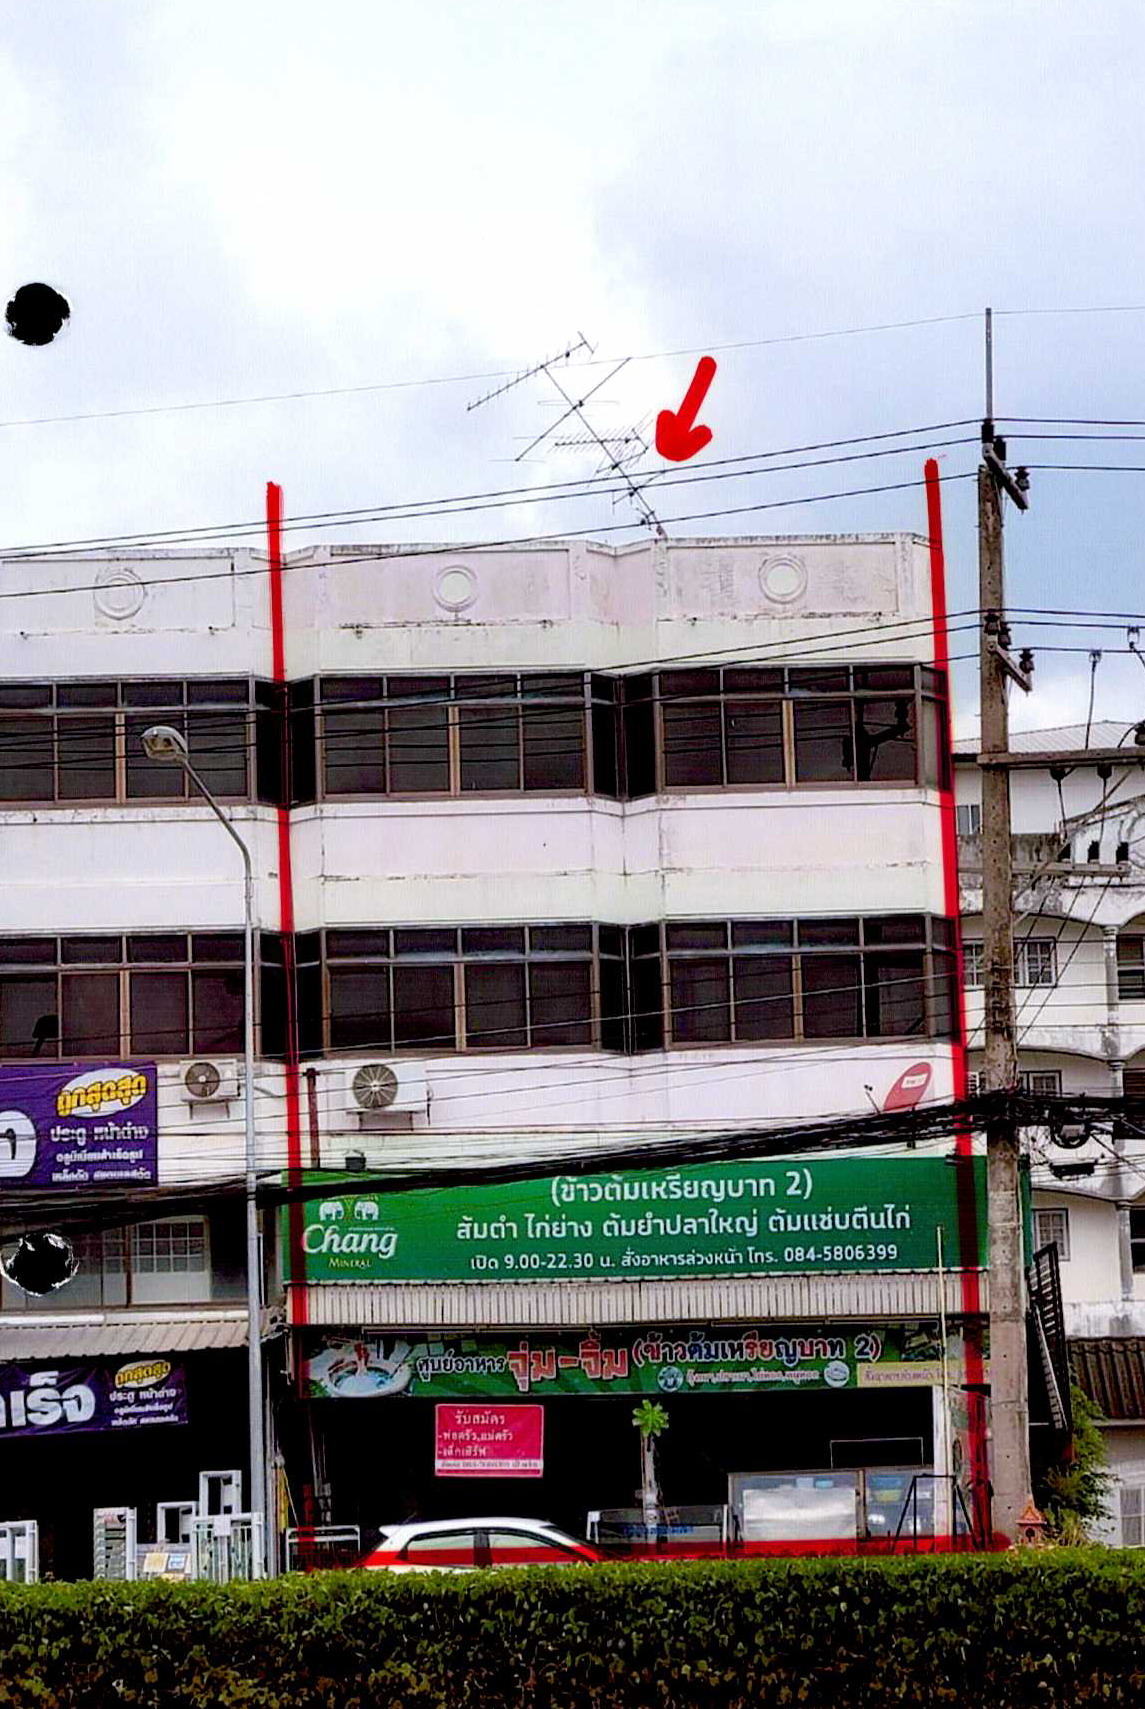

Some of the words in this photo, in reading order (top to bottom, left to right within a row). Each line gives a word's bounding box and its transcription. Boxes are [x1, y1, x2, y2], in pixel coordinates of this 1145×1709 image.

[50, 1125, 87, 1146] ประตู
[94, 1121, 149, 1141] หน้าต่าง
[552, 1171, 775, 1207] (ข้าวต้มเหรียญบาท
[786, 1168, 814, 1200] 2)
[456, 1215, 518, 1240] ส้มตำ
[524, 1213, 593, 1239] ไก่ย่าง
[602, 1208, 758, 1237] ต้มยำปลาใหญ่
[768, 1204, 911, 1233] ต้มแซ่บตีนไก่
[302, 1224, 398, 1259] Chang
[470, 1255, 499, 1270] เปิด
[504, 1252, 593, 1270] 9.00-22.30
[600, 1255, 615, 1268] น.
[621, 1246, 743, 1267] สั่งอาหารล่วงหน้า
[748, 1246, 778, 1264] โทร.
[784, 1244, 898, 1263] 084-5806399
[632, 1330, 845, 1367] (ข้าวต้มเหรียญบาท
[855, 1334, 883, 1362] 2)
[455, 1409, 505, 1425] รับสมัคร
